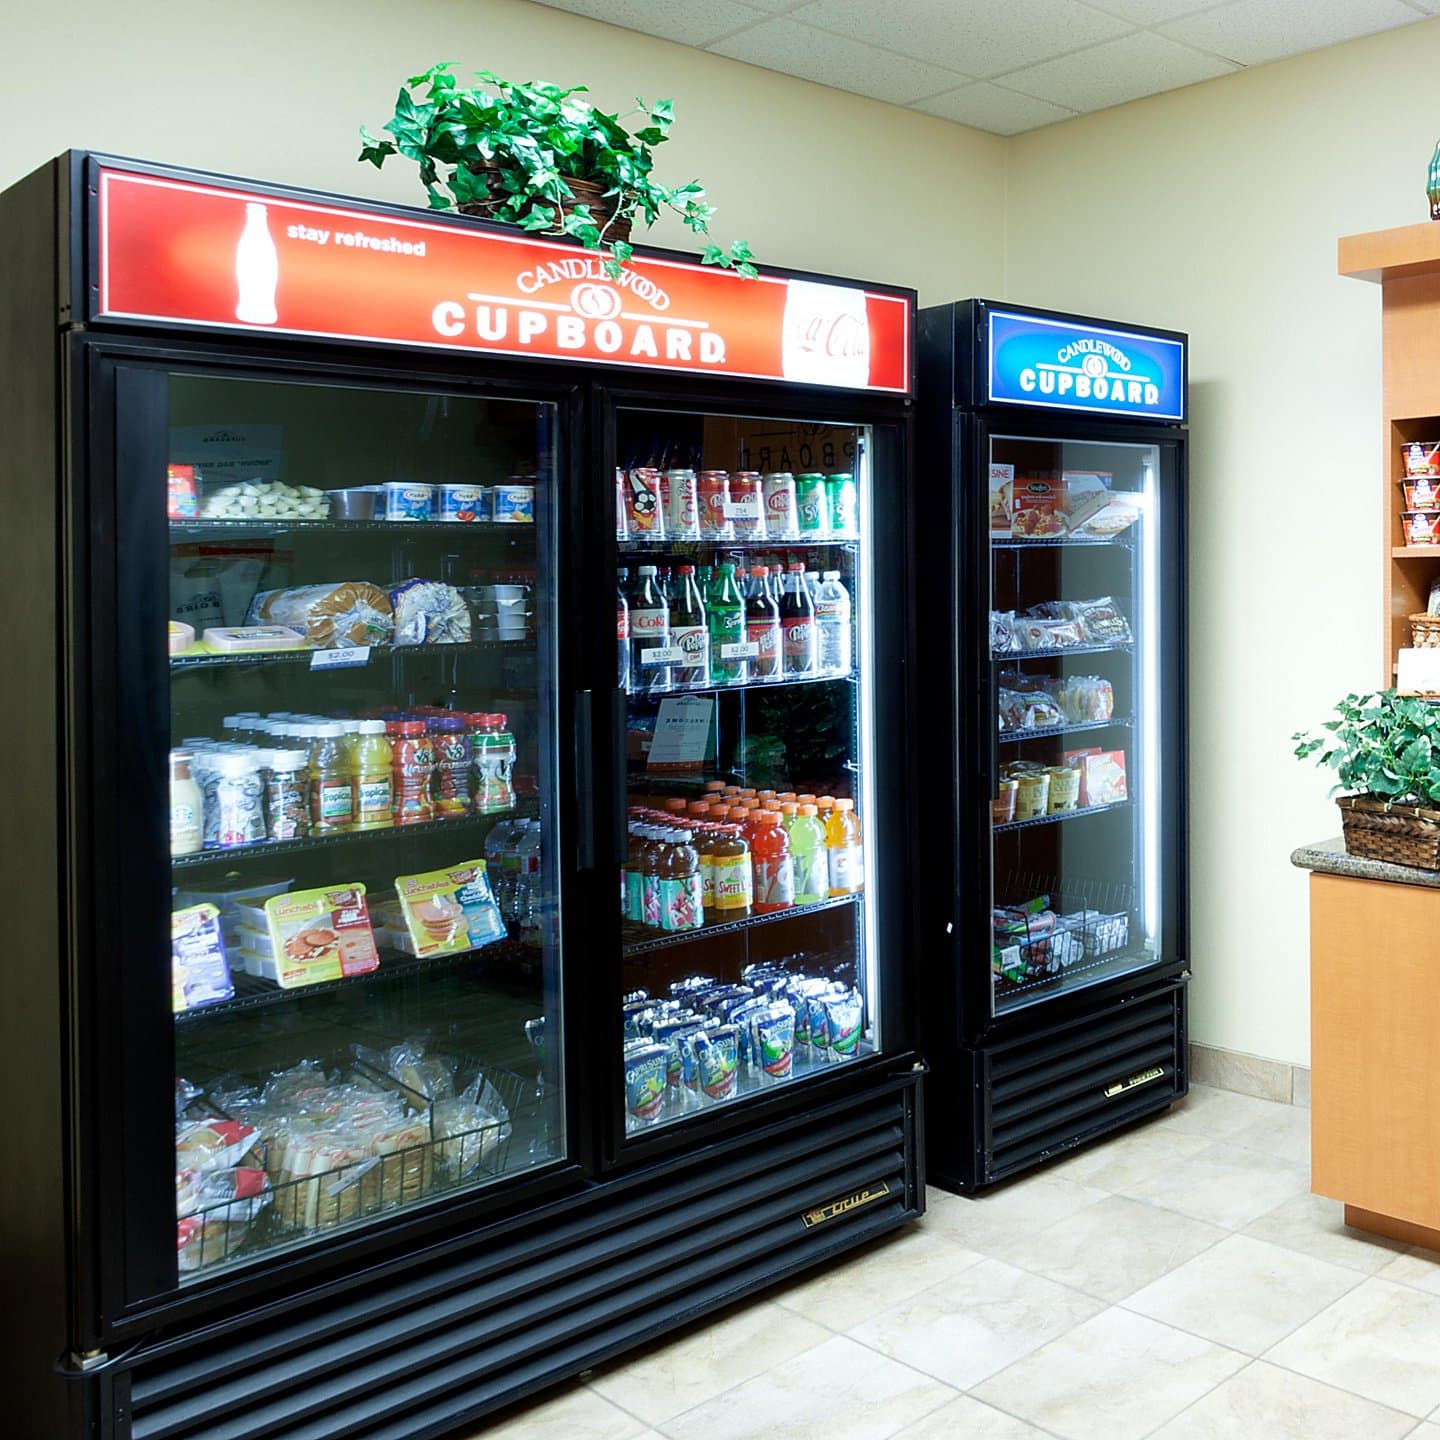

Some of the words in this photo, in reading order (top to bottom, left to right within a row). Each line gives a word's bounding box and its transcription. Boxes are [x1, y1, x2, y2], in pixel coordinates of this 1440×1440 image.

[287, 222, 330, 244] stay
[334, 230, 427, 257] refreshed
[432, 302, 723, 364] CUPBOARD
[1057, 339, 1131, 372] CANDLEWOOD
[1020, 368, 1158, 405] CUPBOARD
[992, 469, 1009, 478] SINE
[652, 650, 672, 659] $2.00
